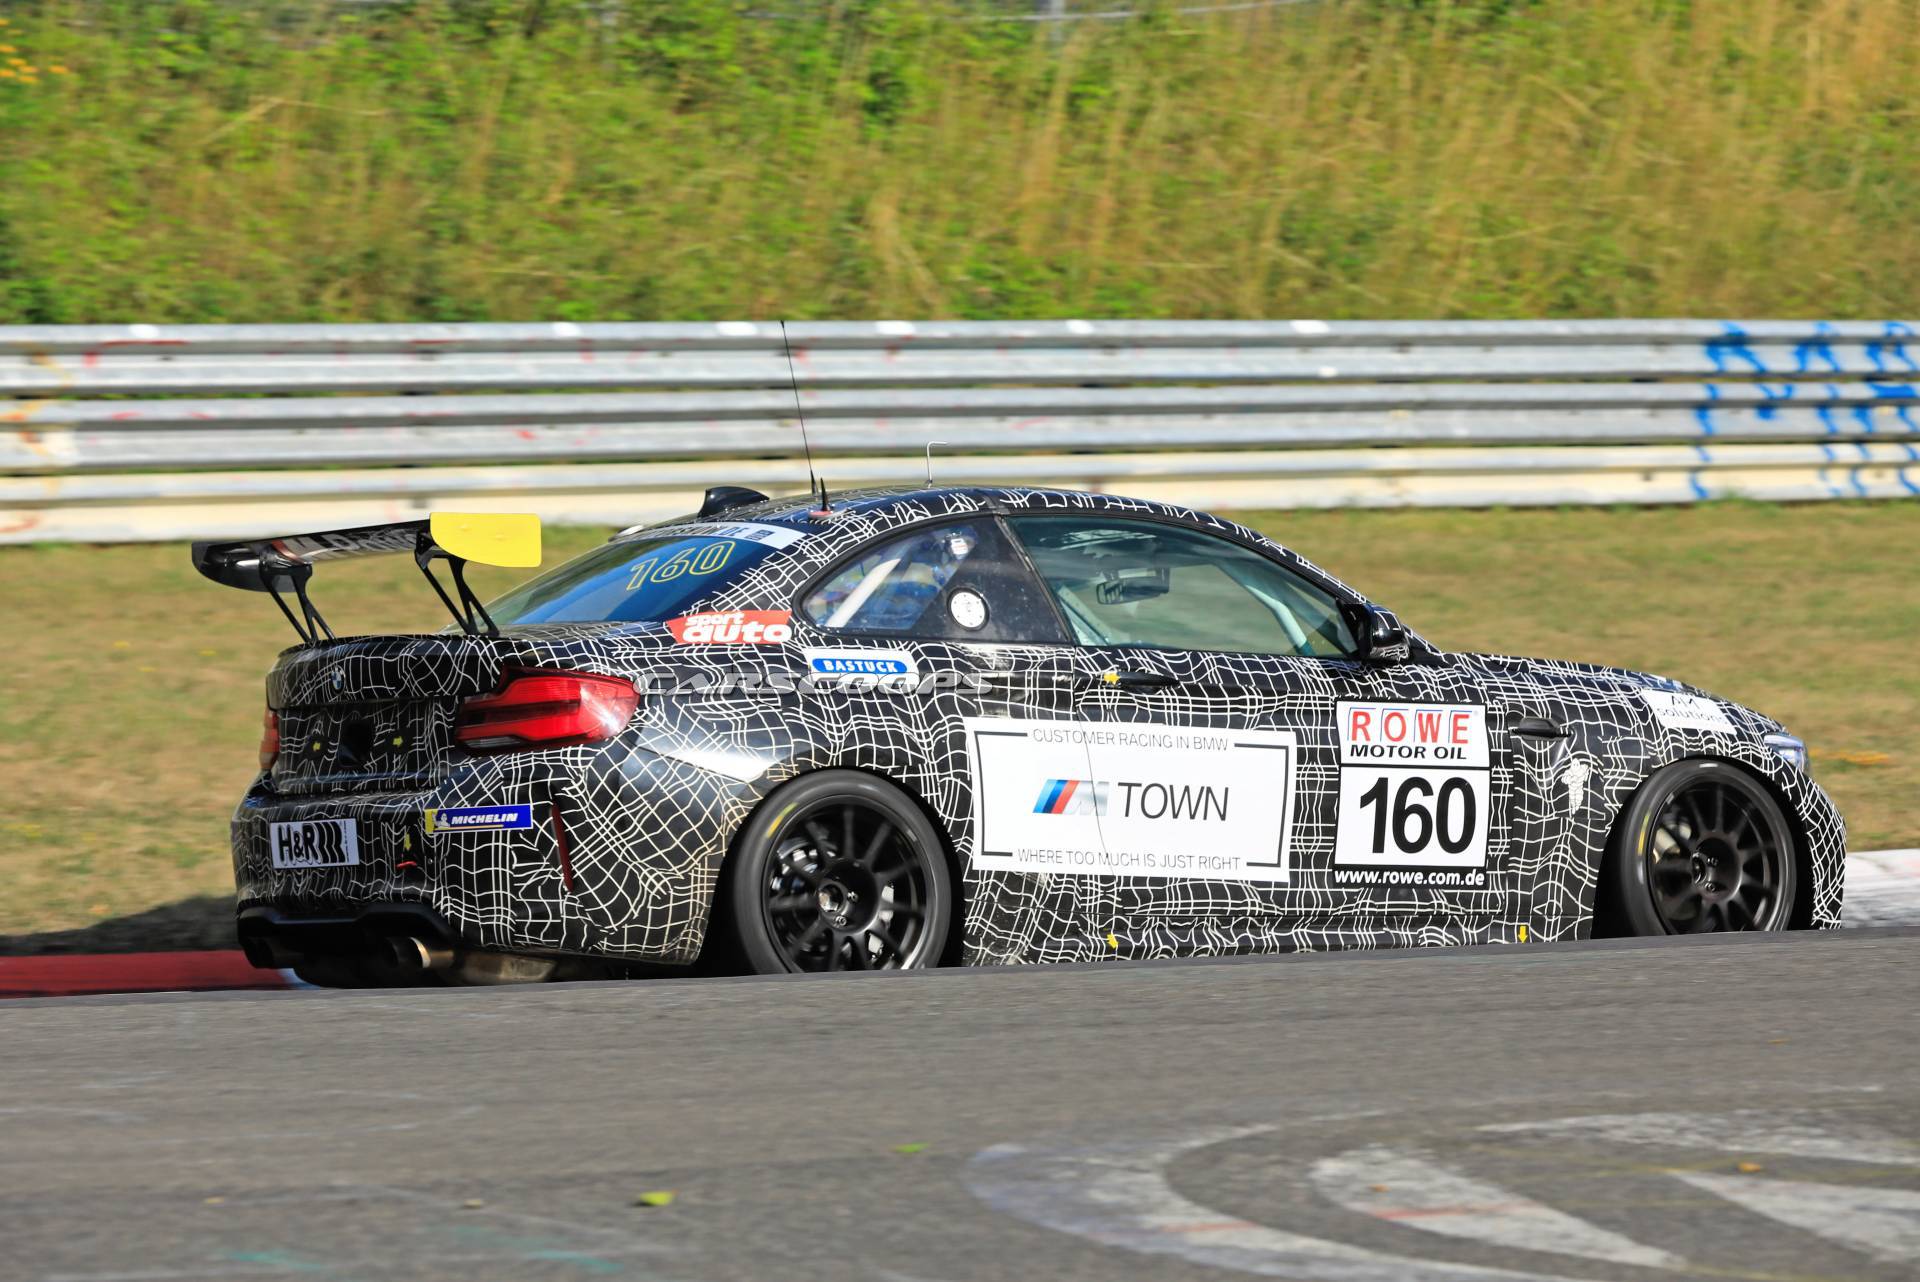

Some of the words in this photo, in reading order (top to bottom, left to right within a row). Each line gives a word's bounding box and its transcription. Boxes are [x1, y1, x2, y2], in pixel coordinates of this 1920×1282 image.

[626, 541, 736, 591] 160
[685, 612, 745, 626] sport
[682, 621, 792, 643] auto
[823, 660, 898, 673] BASTUCK
[1350, 710, 1471, 744] ROWE
[1033, 728, 1115, 745] CUSTOMER
[1119, 732, 1173, 748] RACING
[1177, 736, 1190, 749] IN
[1194, 737, 1229, 751] BMW
[1350, 744, 1426, 760] MOTOR
[1434, 746, 1468, 760] OIL
[1118, 781, 1229, 821] TOWN
[451, 813, 518, 825] MICHELIN
[1360, 776, 1477, 854] 160
[278, 822, 346, 865] H&R
[1018, 848, 1063, 864] WHERE
[1066, 850, 1095, 866] TOO
[1099, 852, 1140, 867] MUCH
[1143, 854, 1156, 868] IS
[1159, 855, 1196, 869] JUST
[1199, 856, 1241, 871] RIGHT
[1334, 868, 1485, 886] www.rowe.com.de
